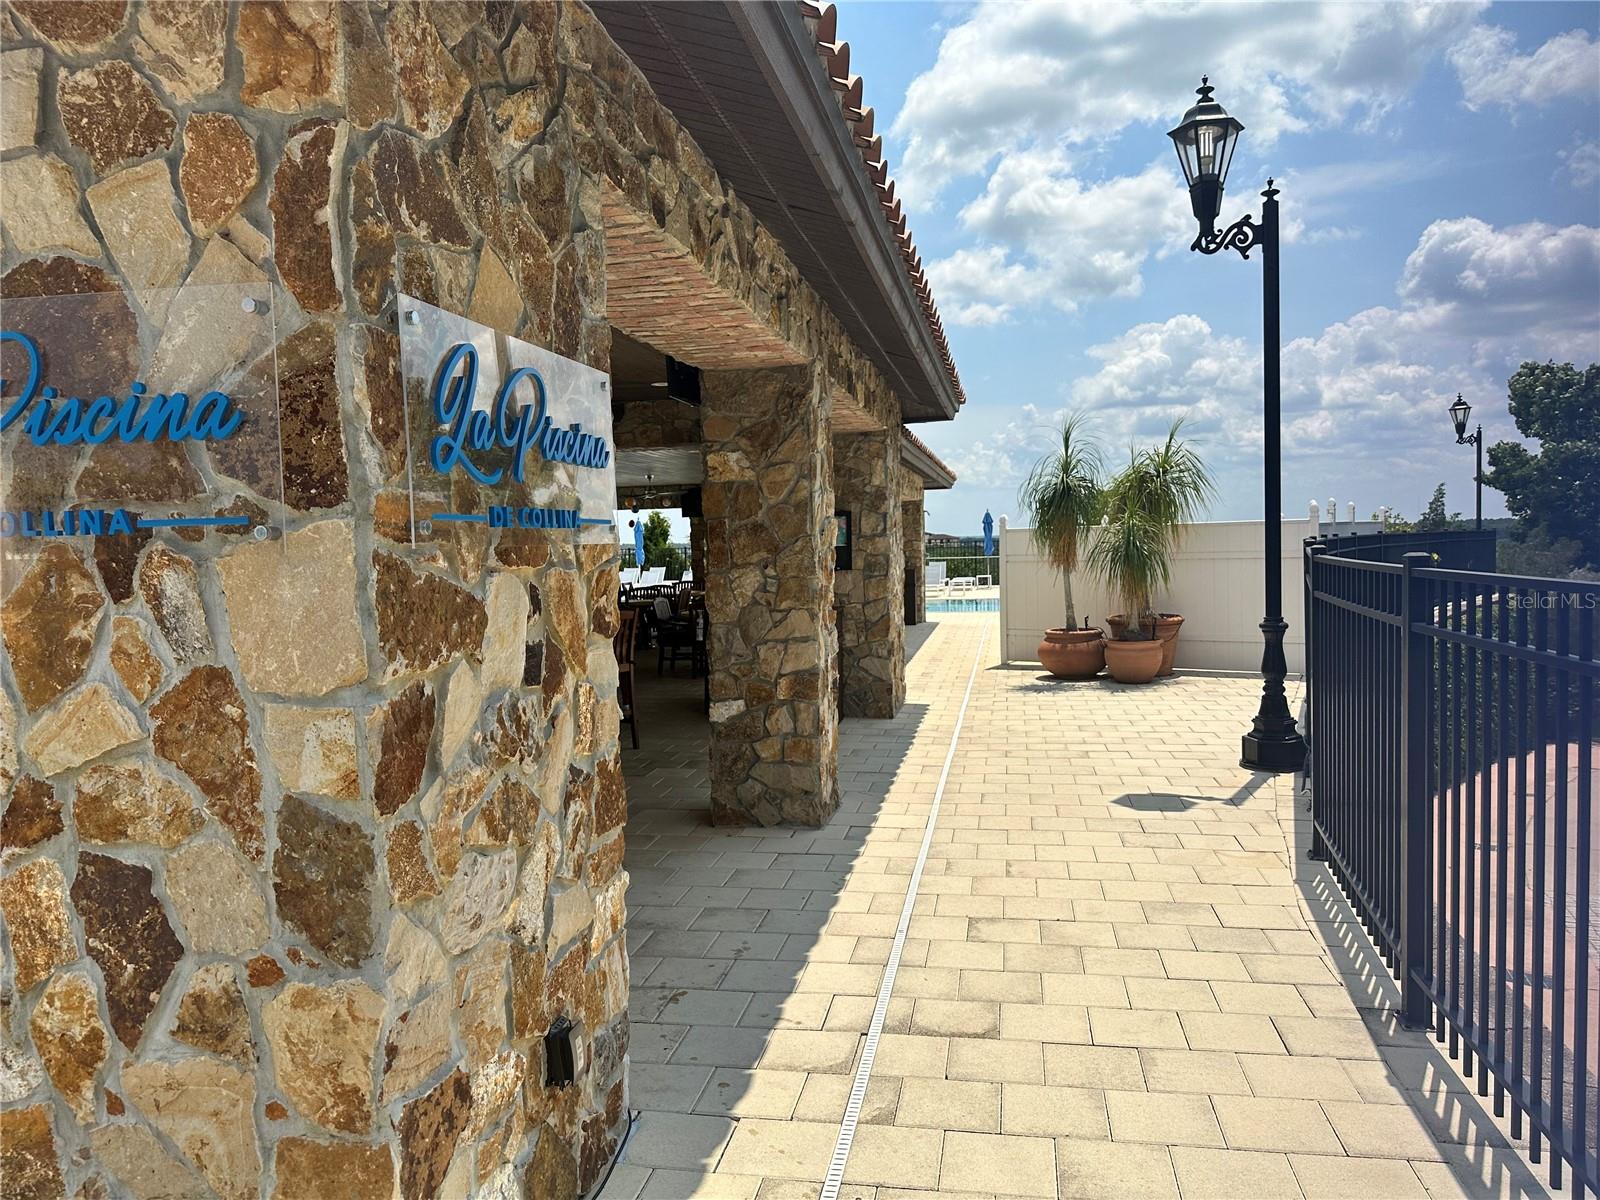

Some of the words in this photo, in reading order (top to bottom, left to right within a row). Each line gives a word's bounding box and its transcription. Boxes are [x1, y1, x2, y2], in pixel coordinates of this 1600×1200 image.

[431, 343, 503, 485] La
[497, 367, 610, 484] Piscina
[489, 506, 513, 528] DE
[518, 507, 581, 528] COLLINA
